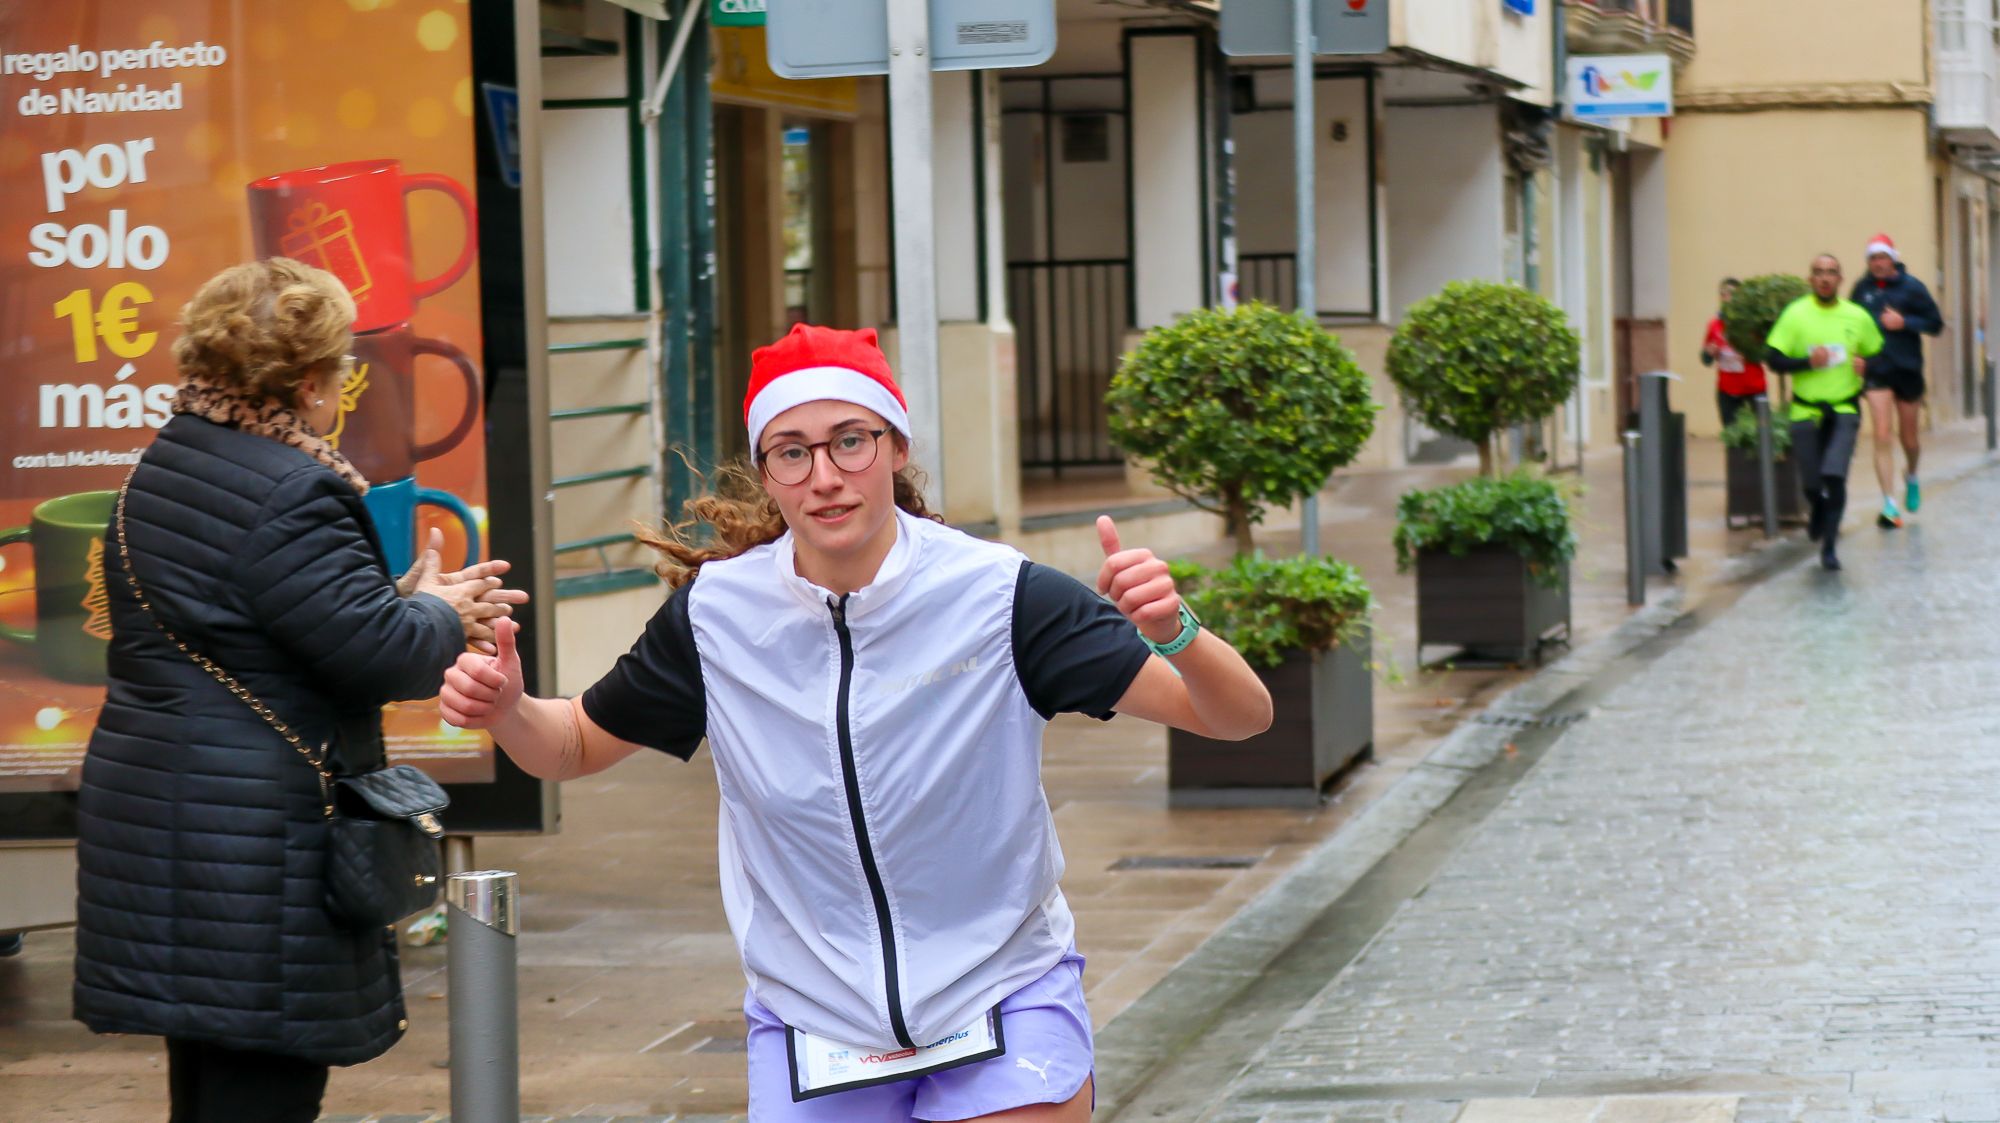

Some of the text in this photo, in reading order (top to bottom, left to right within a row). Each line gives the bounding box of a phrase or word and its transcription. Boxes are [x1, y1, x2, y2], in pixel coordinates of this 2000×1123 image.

[3, 44, 98, 81] regalo
[101, 41, 226, 78] perfecto
[18, 83, 182, 116] de Navidad
[41, 137, 154, 213] por
[28, 209, 170, 270] solo
[54, 282, 158, 363] 1€
[39, 362, 176, 429] más
[12, 455, 46, 469] con
[47, 452, 66, 468] tu
